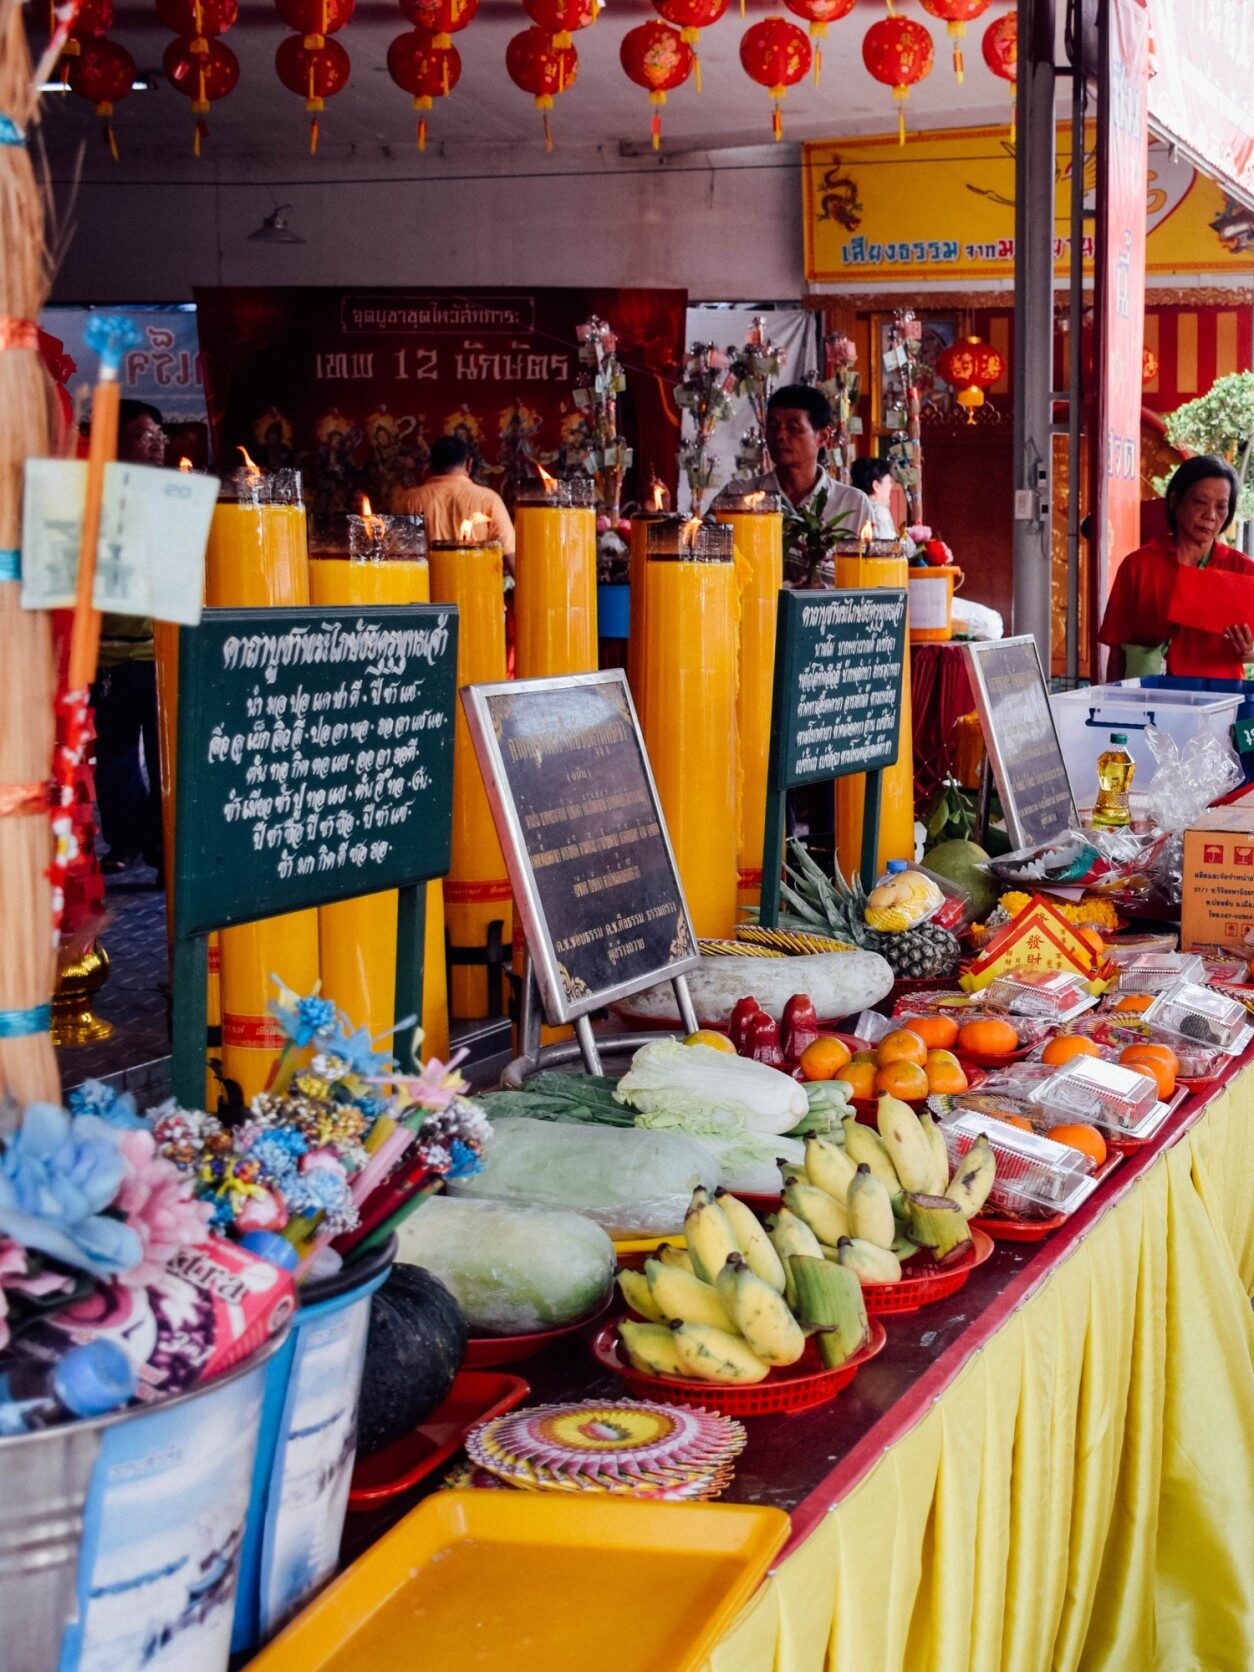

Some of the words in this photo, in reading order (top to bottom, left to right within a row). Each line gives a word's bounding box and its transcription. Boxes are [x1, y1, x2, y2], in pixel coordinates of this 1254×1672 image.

[841, 236, 960, 267] เสียงธรรม
[316, 353, 374, 379] เทพ
[394, 348, 439, 381] 12
[455, 340, 569, 381] นักษัตร
